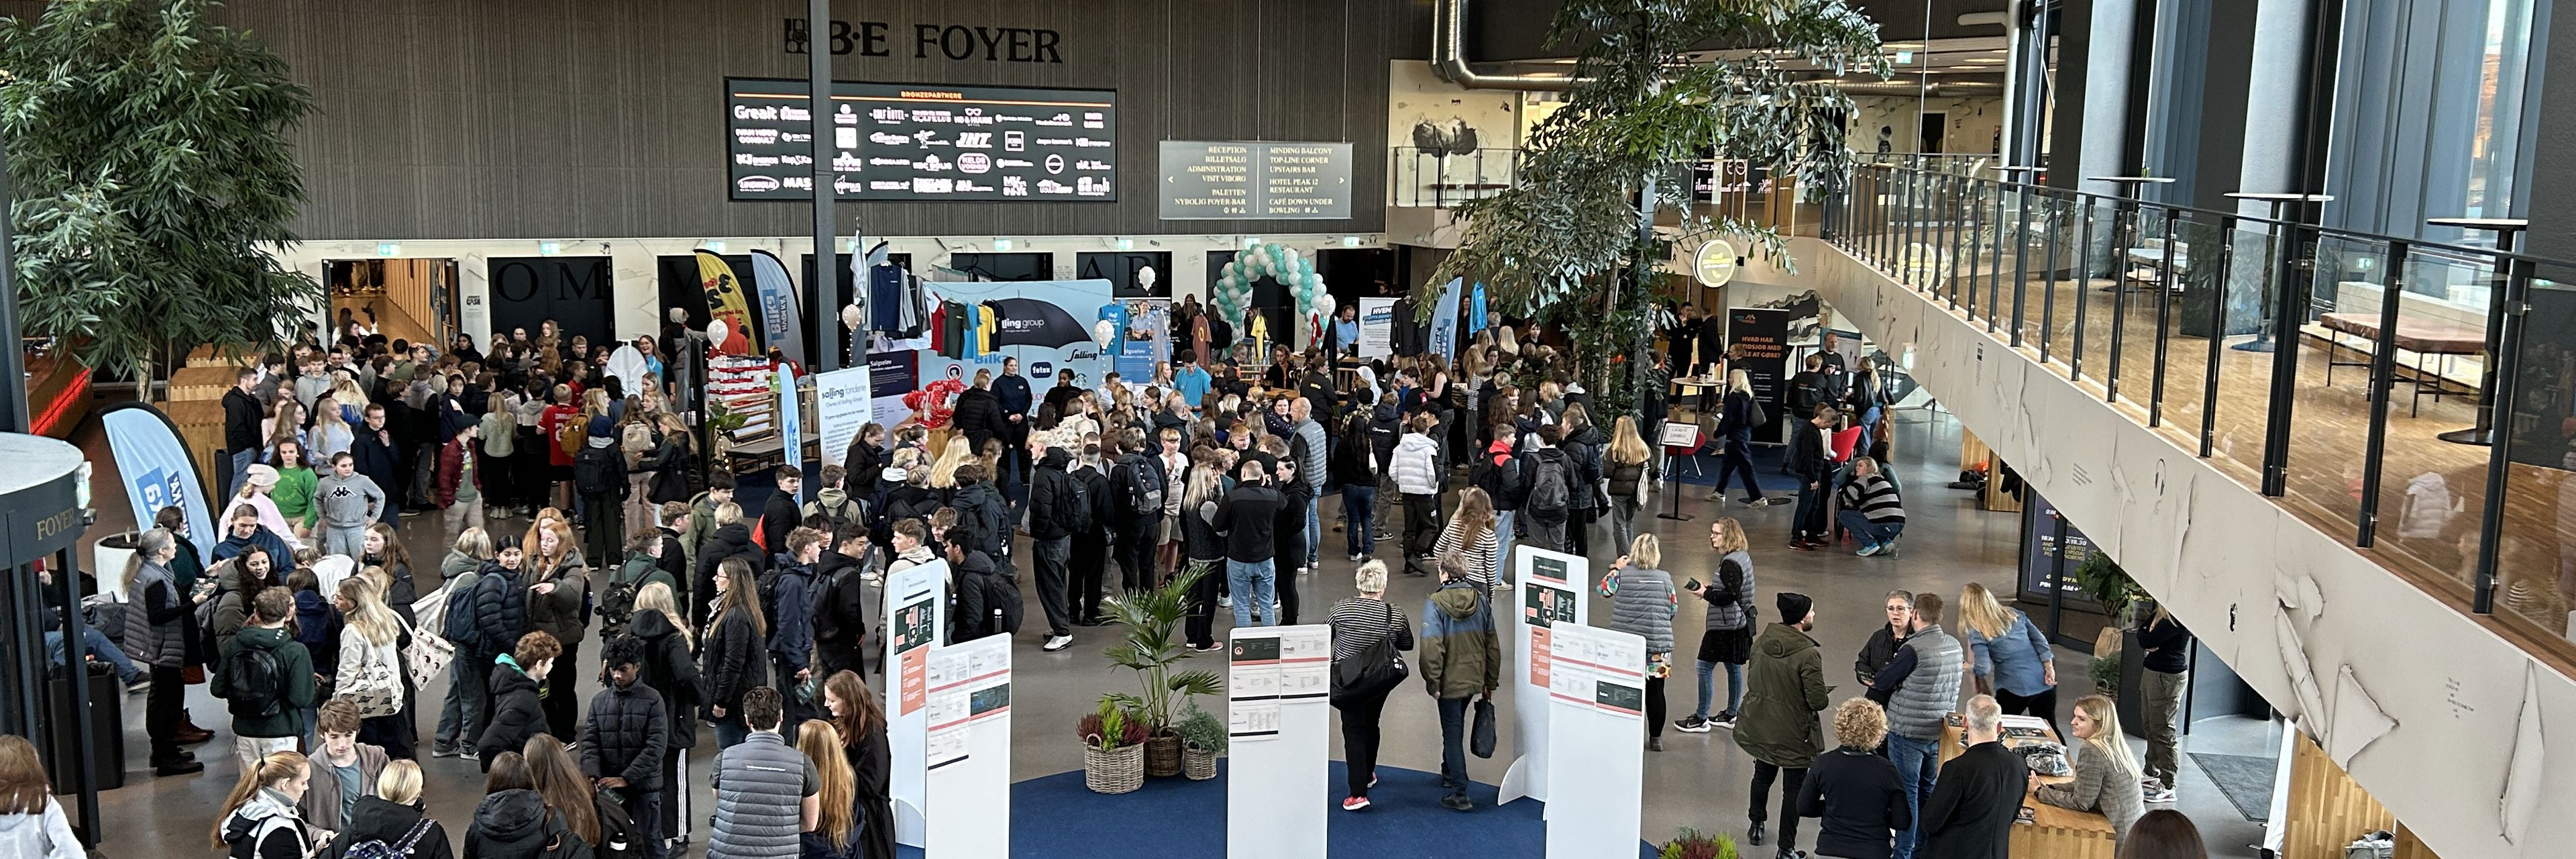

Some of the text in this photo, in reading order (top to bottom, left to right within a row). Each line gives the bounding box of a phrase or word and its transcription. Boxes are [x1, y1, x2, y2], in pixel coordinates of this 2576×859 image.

[914, 23, 1063, 64] FOYER
[1269, 197, 1287, 205] CAFÉ
[1022, 319, 1045, 328] group
[1065, 348, 1097, 362] Salling
[822, 387, 845, 399] salling
[36, 507, 75, 541] FOYER
